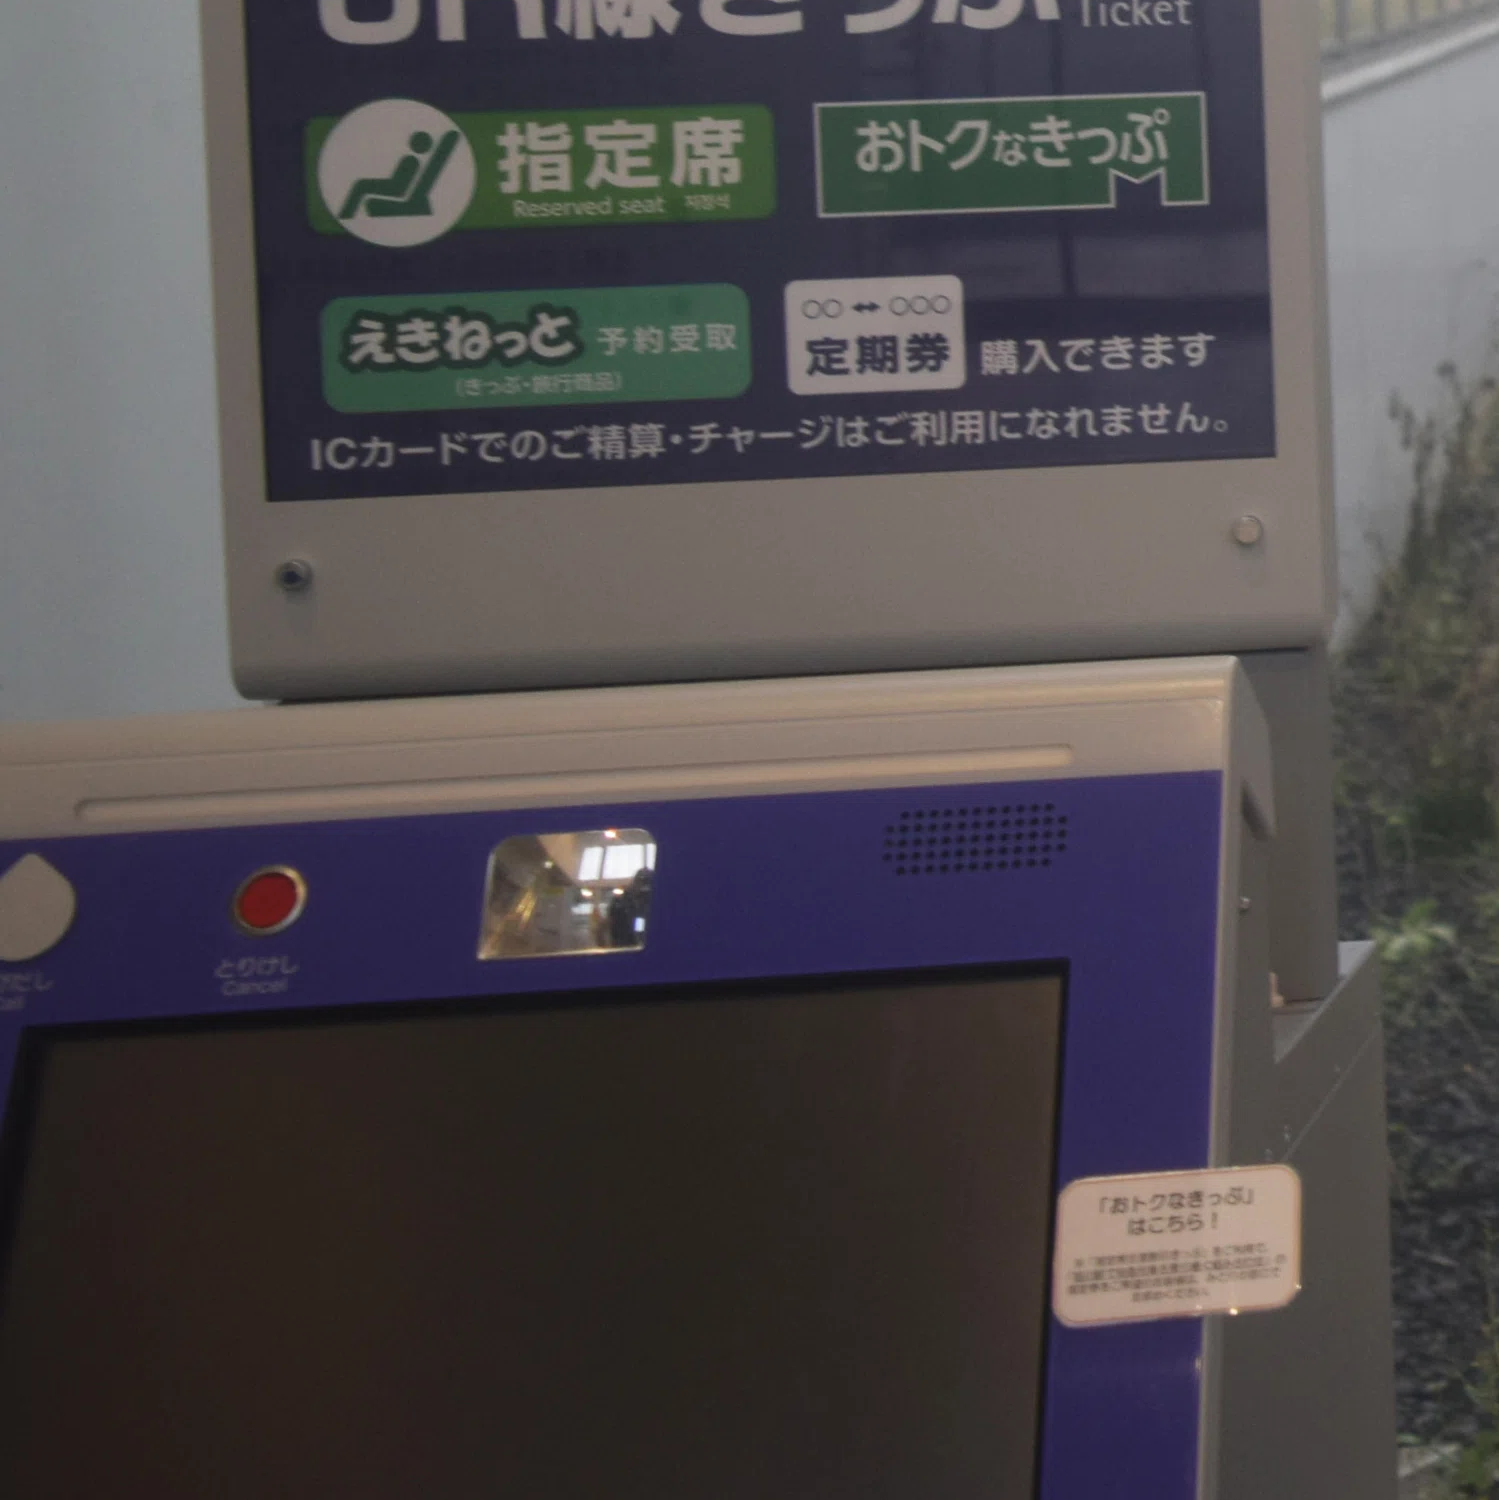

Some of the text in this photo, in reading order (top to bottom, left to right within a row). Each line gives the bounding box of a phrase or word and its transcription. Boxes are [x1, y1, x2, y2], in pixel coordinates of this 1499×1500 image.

[495, 117, 745, 194] 指定席
[855, 108, 1171, 173] おトクなきっぷ
[513, 195, 666, 217] Reserved seat
[344, 308, 738, 368] えきねっと 予約受取
[806, 331, 951, 376] 定期券
[980, 332, 1216, 376] 購入できます
[213, 956, 300, 978] とりけし
